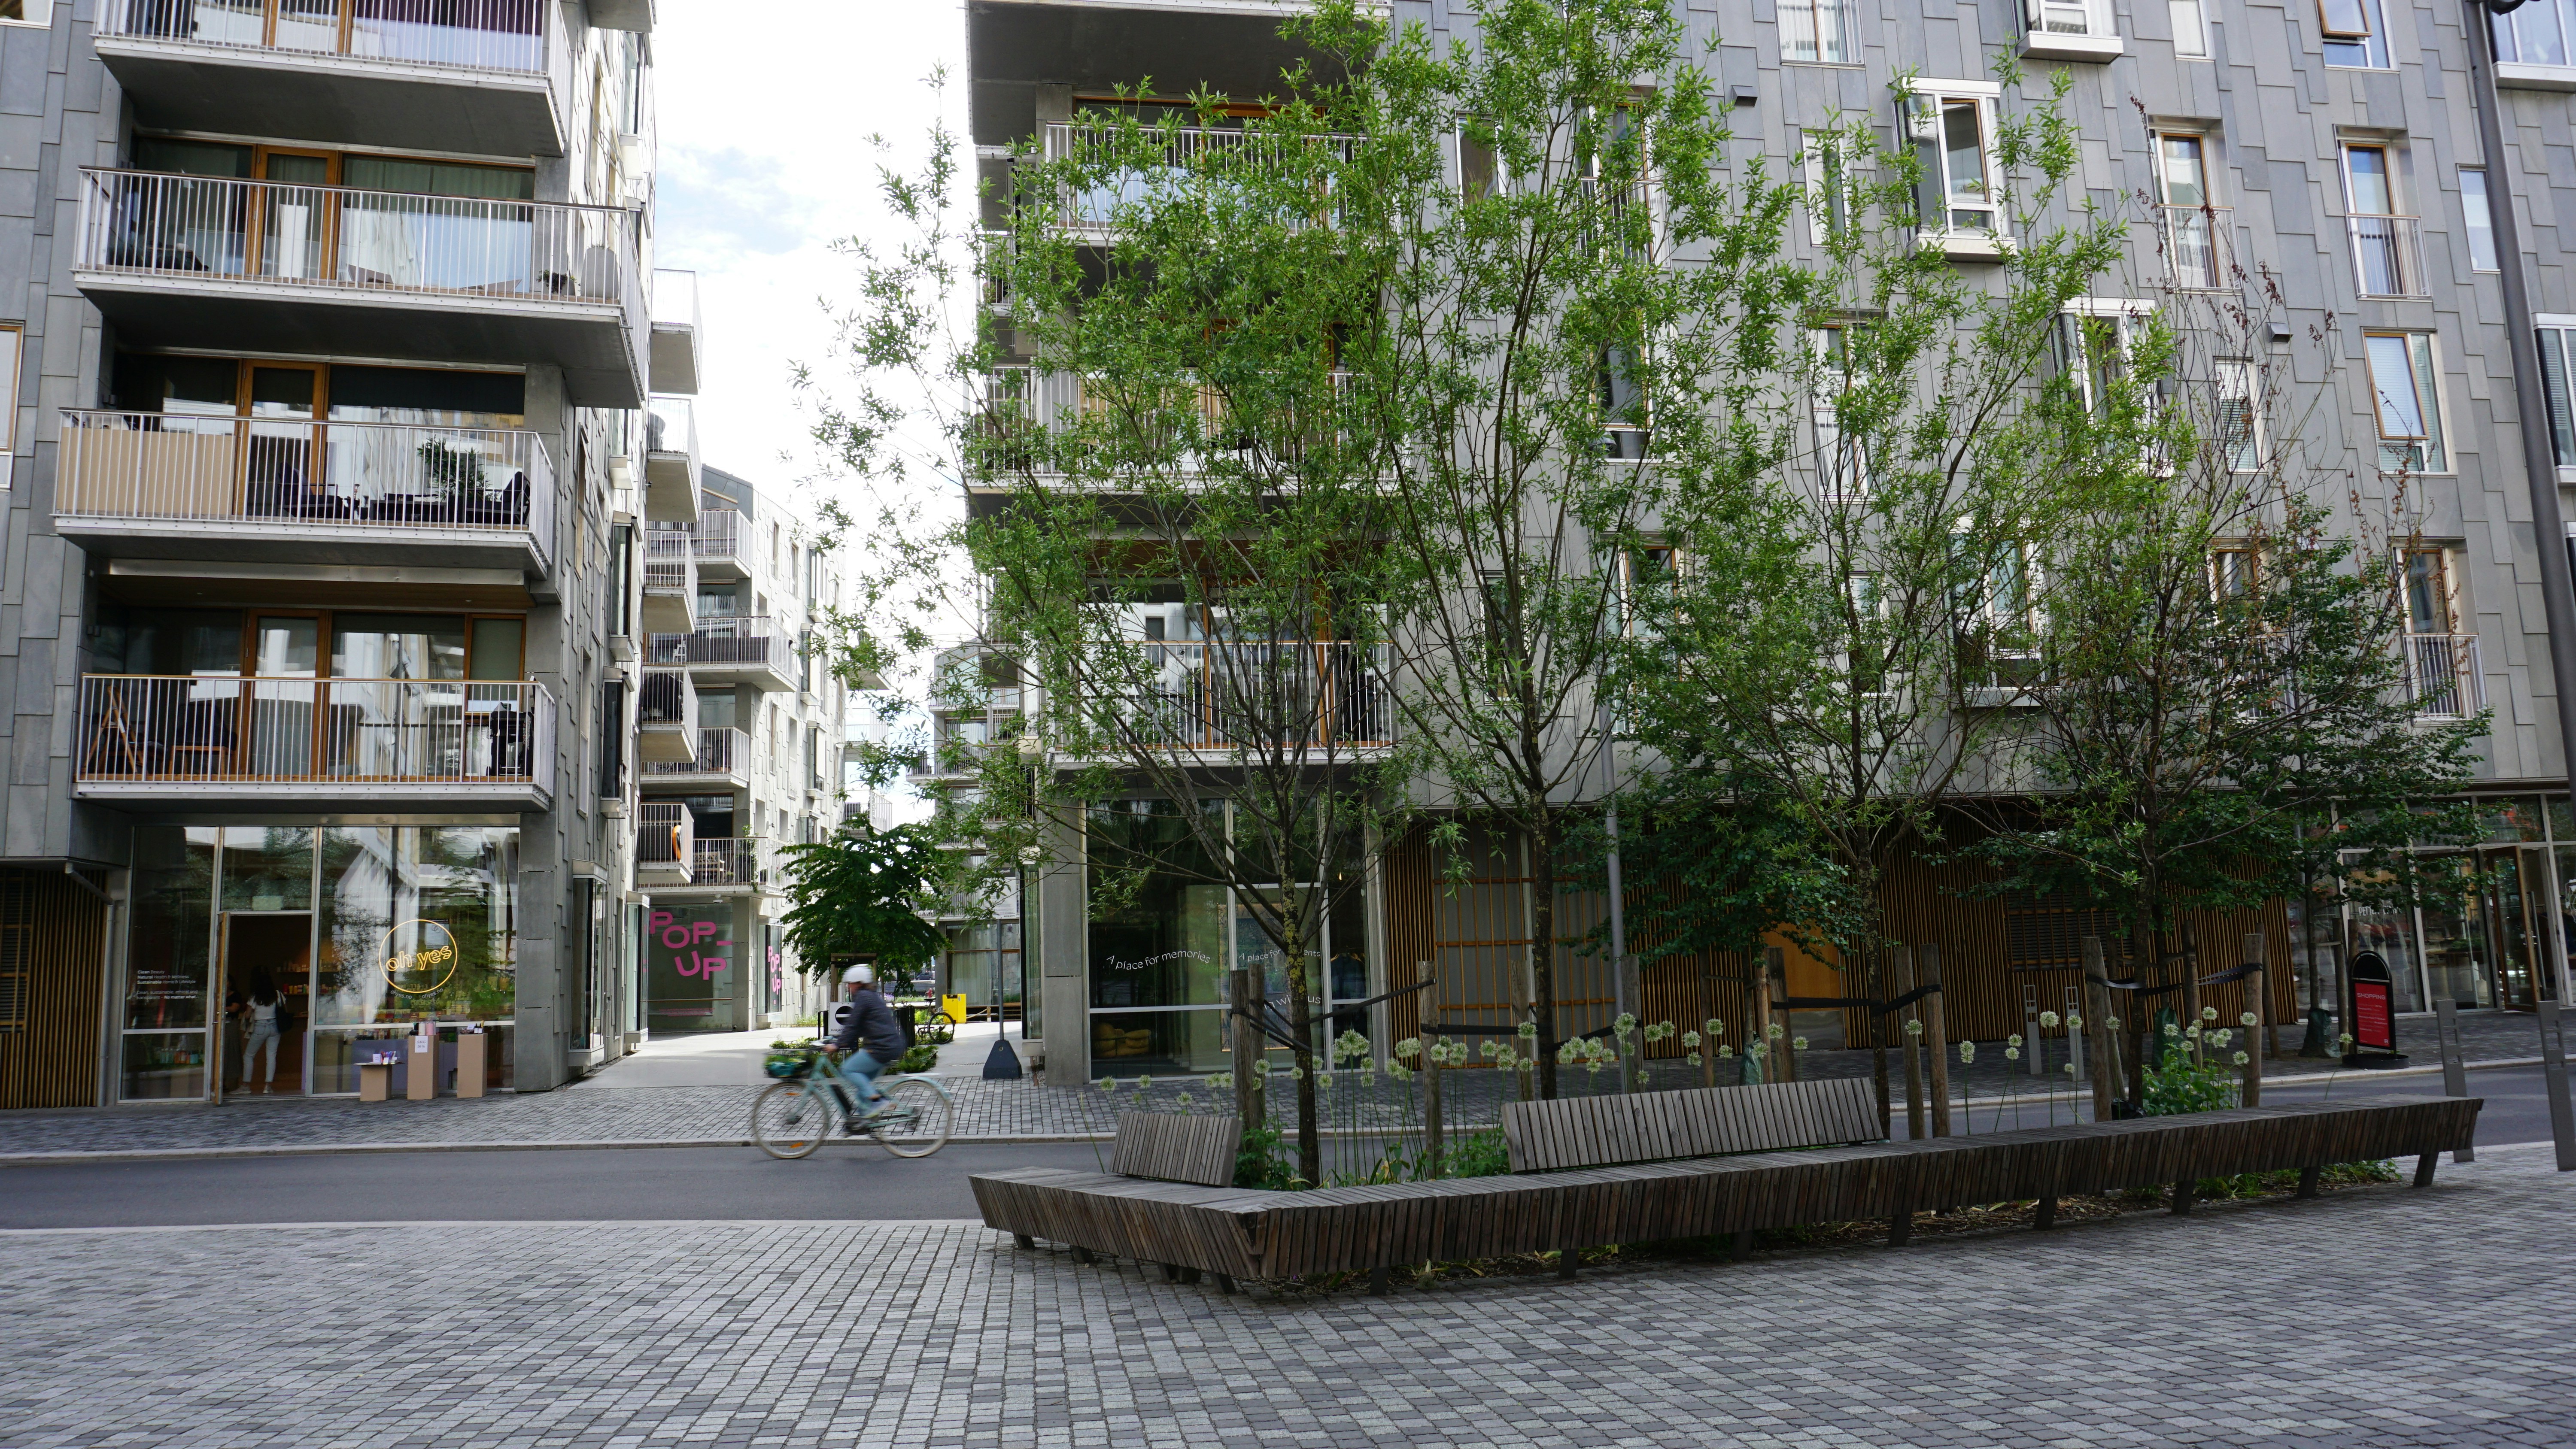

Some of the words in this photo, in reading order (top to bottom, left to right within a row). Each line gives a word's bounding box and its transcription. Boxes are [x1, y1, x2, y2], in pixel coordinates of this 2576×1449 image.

[386, 951, 413, 971] oh
[416, 945, 452, 970] yes
[674, 950, 727, 980] UP
[1106, 955, 1115, 964] A
[1115, 961, 1143, 970] place
[1145, 956, 1159, 966] for
[1161, 950, 1211, 964] memories
[1247, 953, 1268, 962] place
[1270, 949, 1282, 957] for
[390, 990, 413, 1000] ohyes.no
[422, 988, 444, 999] ohyes.no
[772, 974, 781, 995] UP
[1307, 995, 1321, 1004] us
